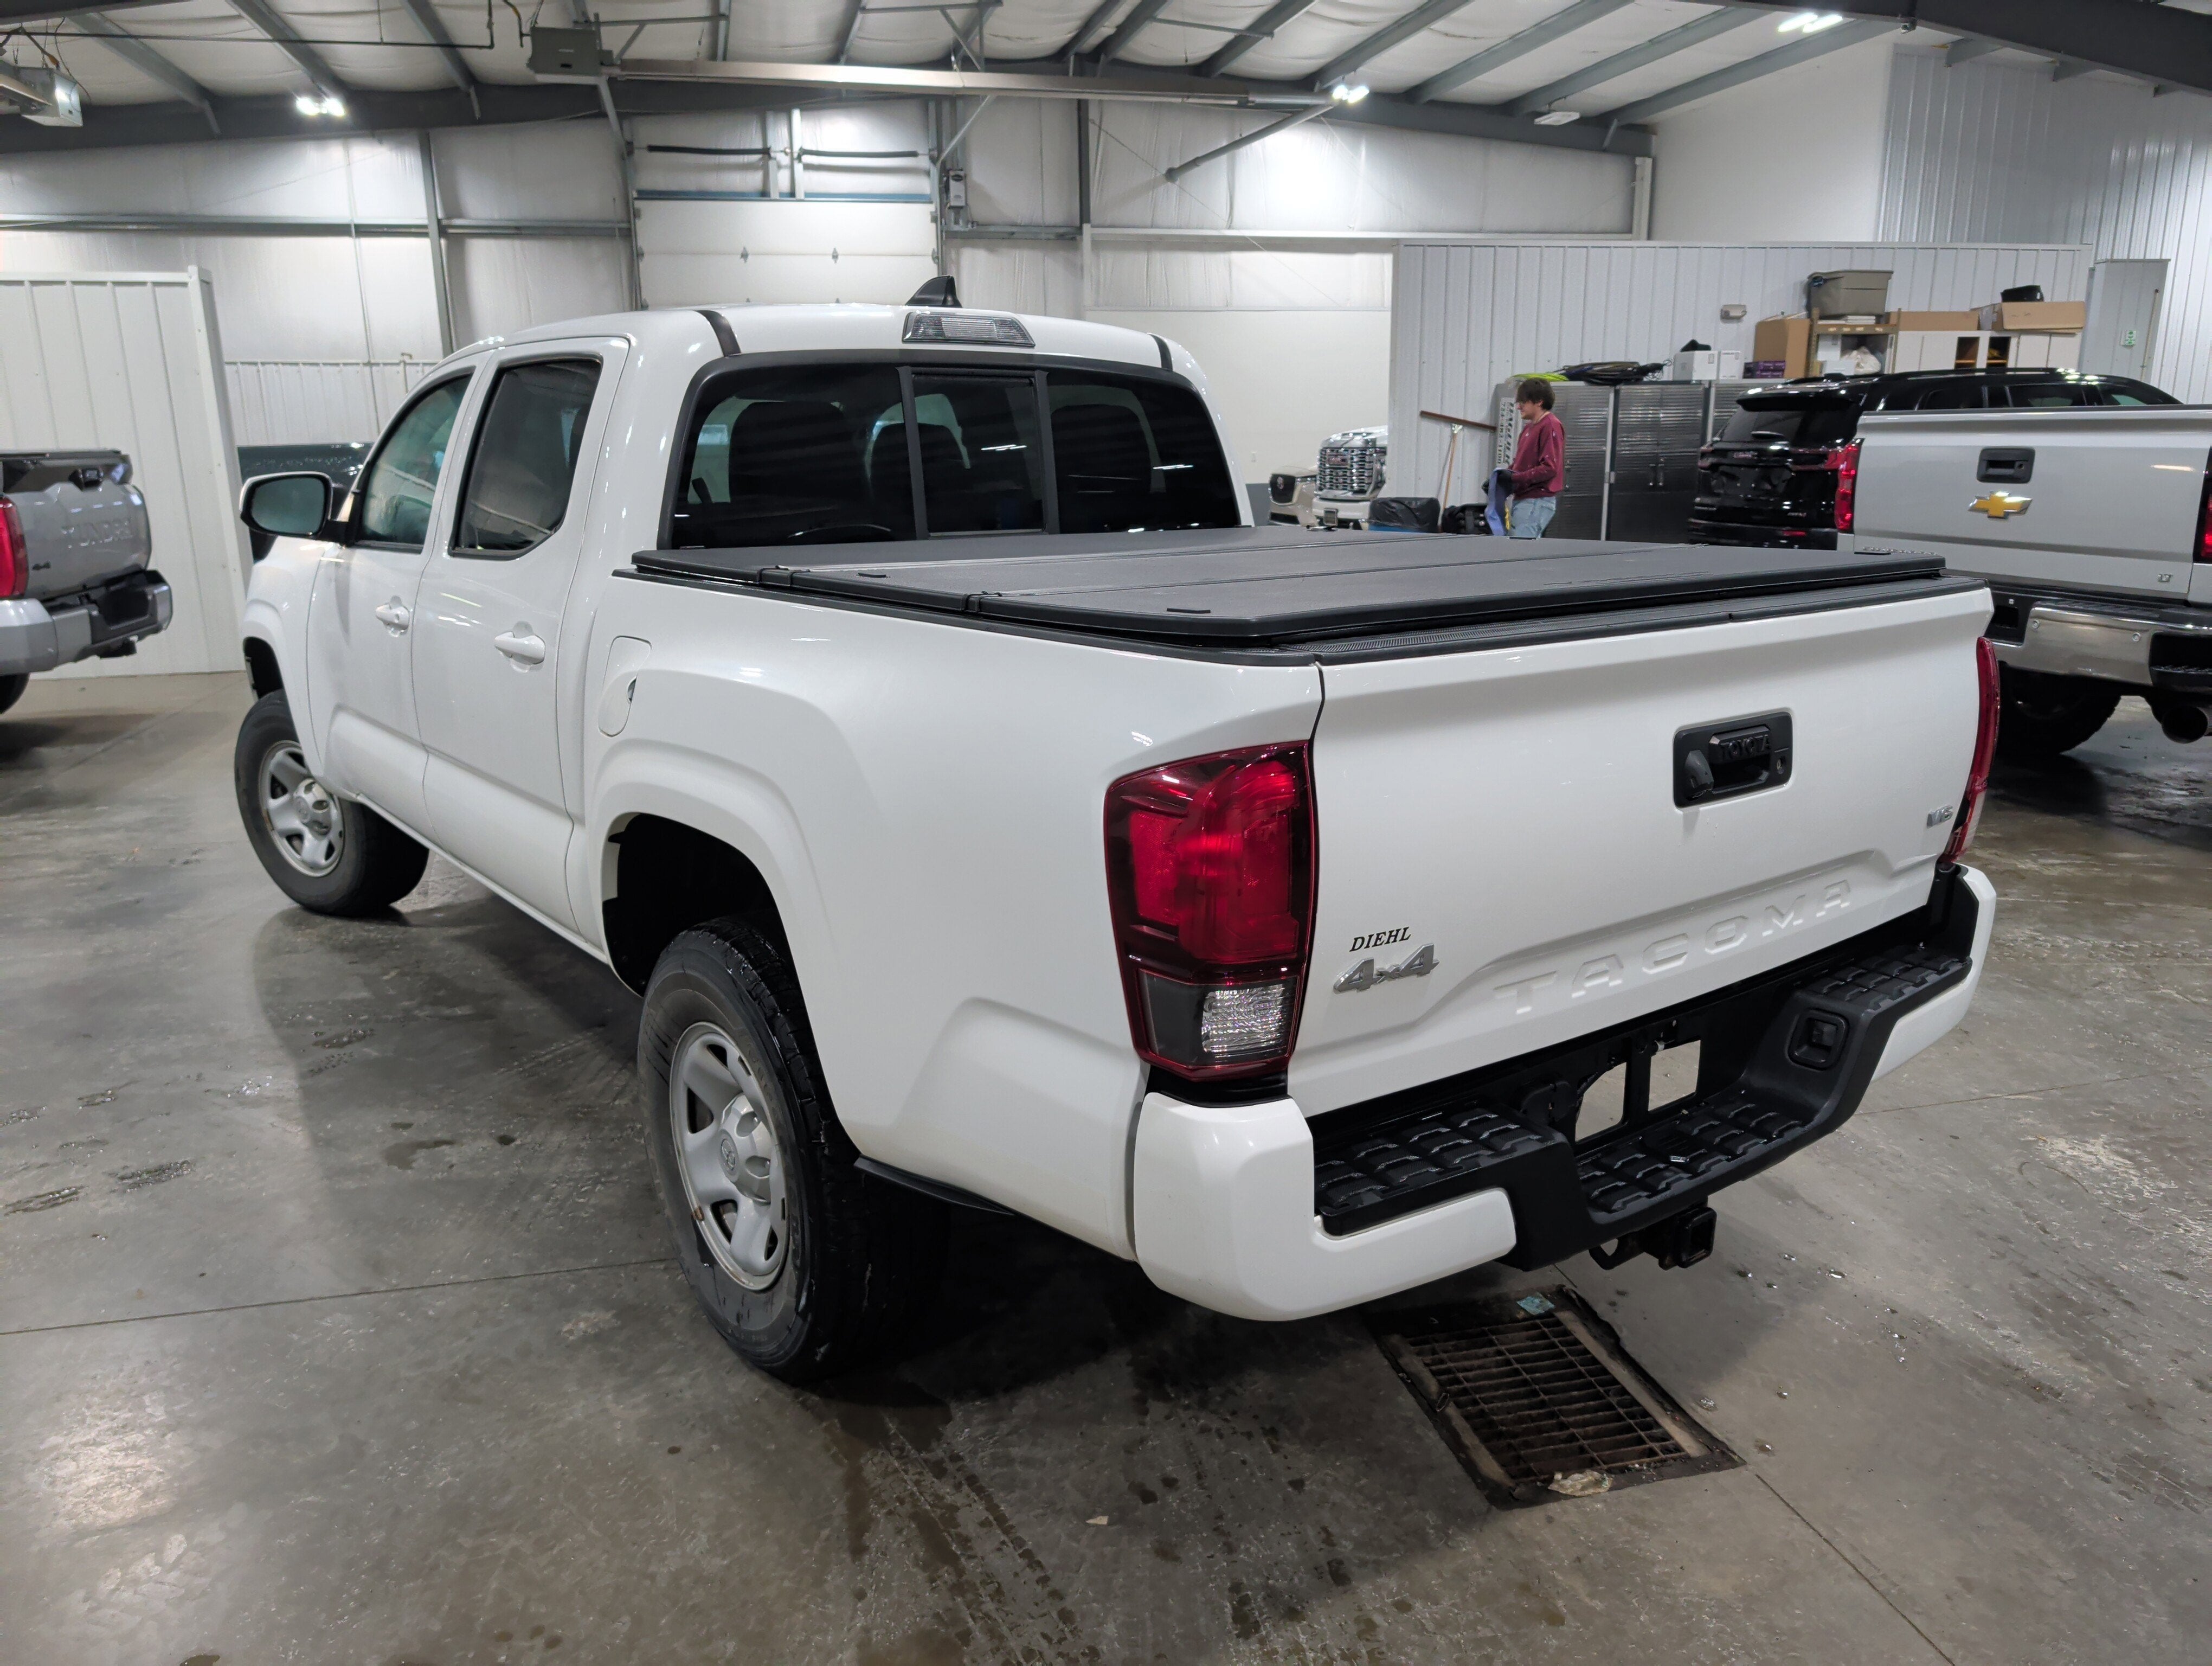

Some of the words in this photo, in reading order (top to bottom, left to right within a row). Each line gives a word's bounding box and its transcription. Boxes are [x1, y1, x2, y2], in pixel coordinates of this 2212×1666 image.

[1720, 734, 1771, 758] TOYOTA
[1926, 805, 1953, 829] V6
[1349, 926, 1411, 952] DIEHL
[1494, 879, 1851, 1015] TACOMA
[1333, 943, 1440, 994] 4x4
